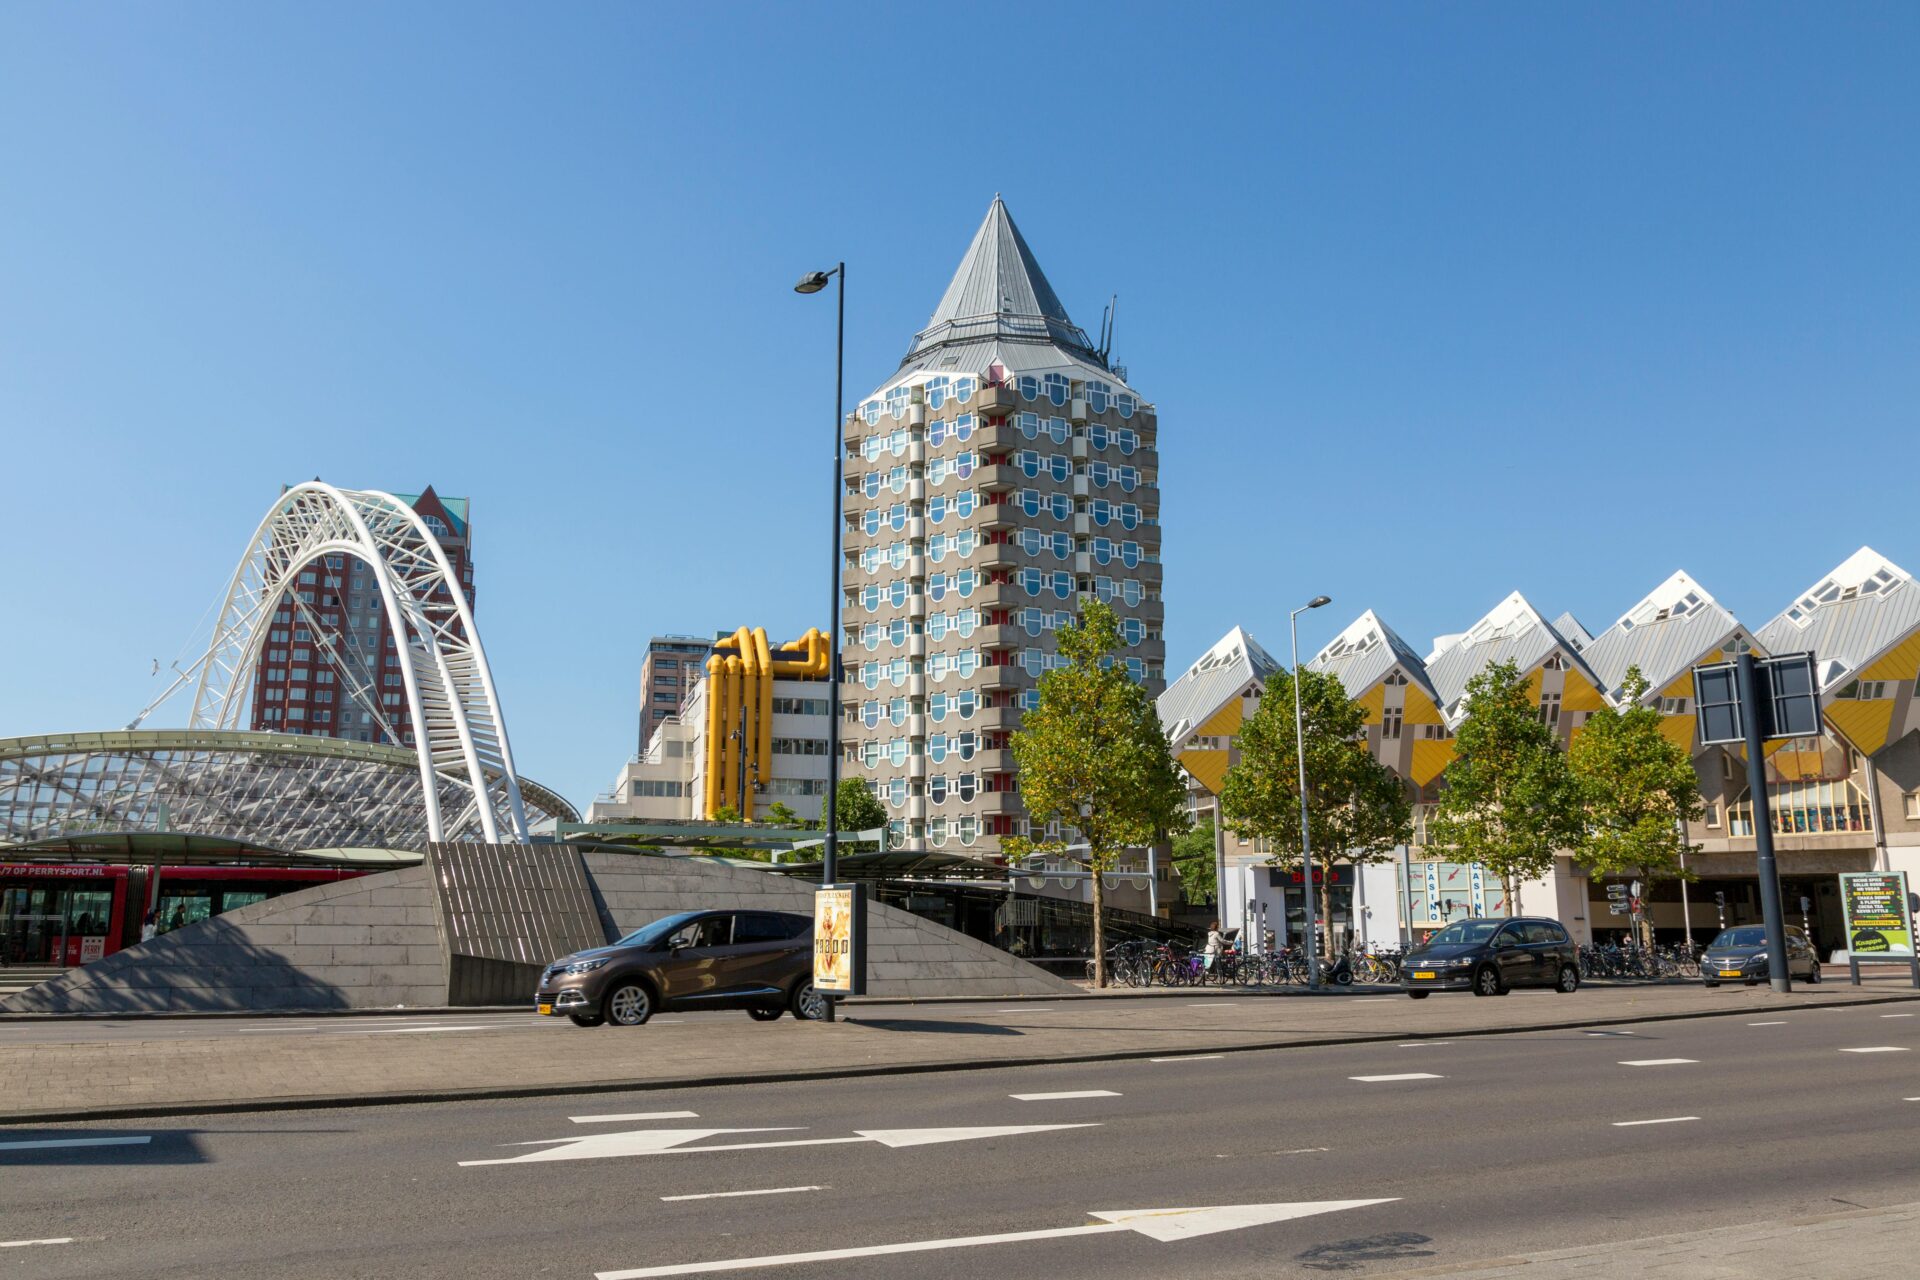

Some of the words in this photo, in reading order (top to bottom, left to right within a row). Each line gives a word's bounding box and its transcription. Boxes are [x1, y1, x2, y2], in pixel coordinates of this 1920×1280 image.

[13, 867, 26, 875] OP
[28, 867, 105, 876] PERRYSPORT.NL
[1427, 863, 1438, 921] CASINO
